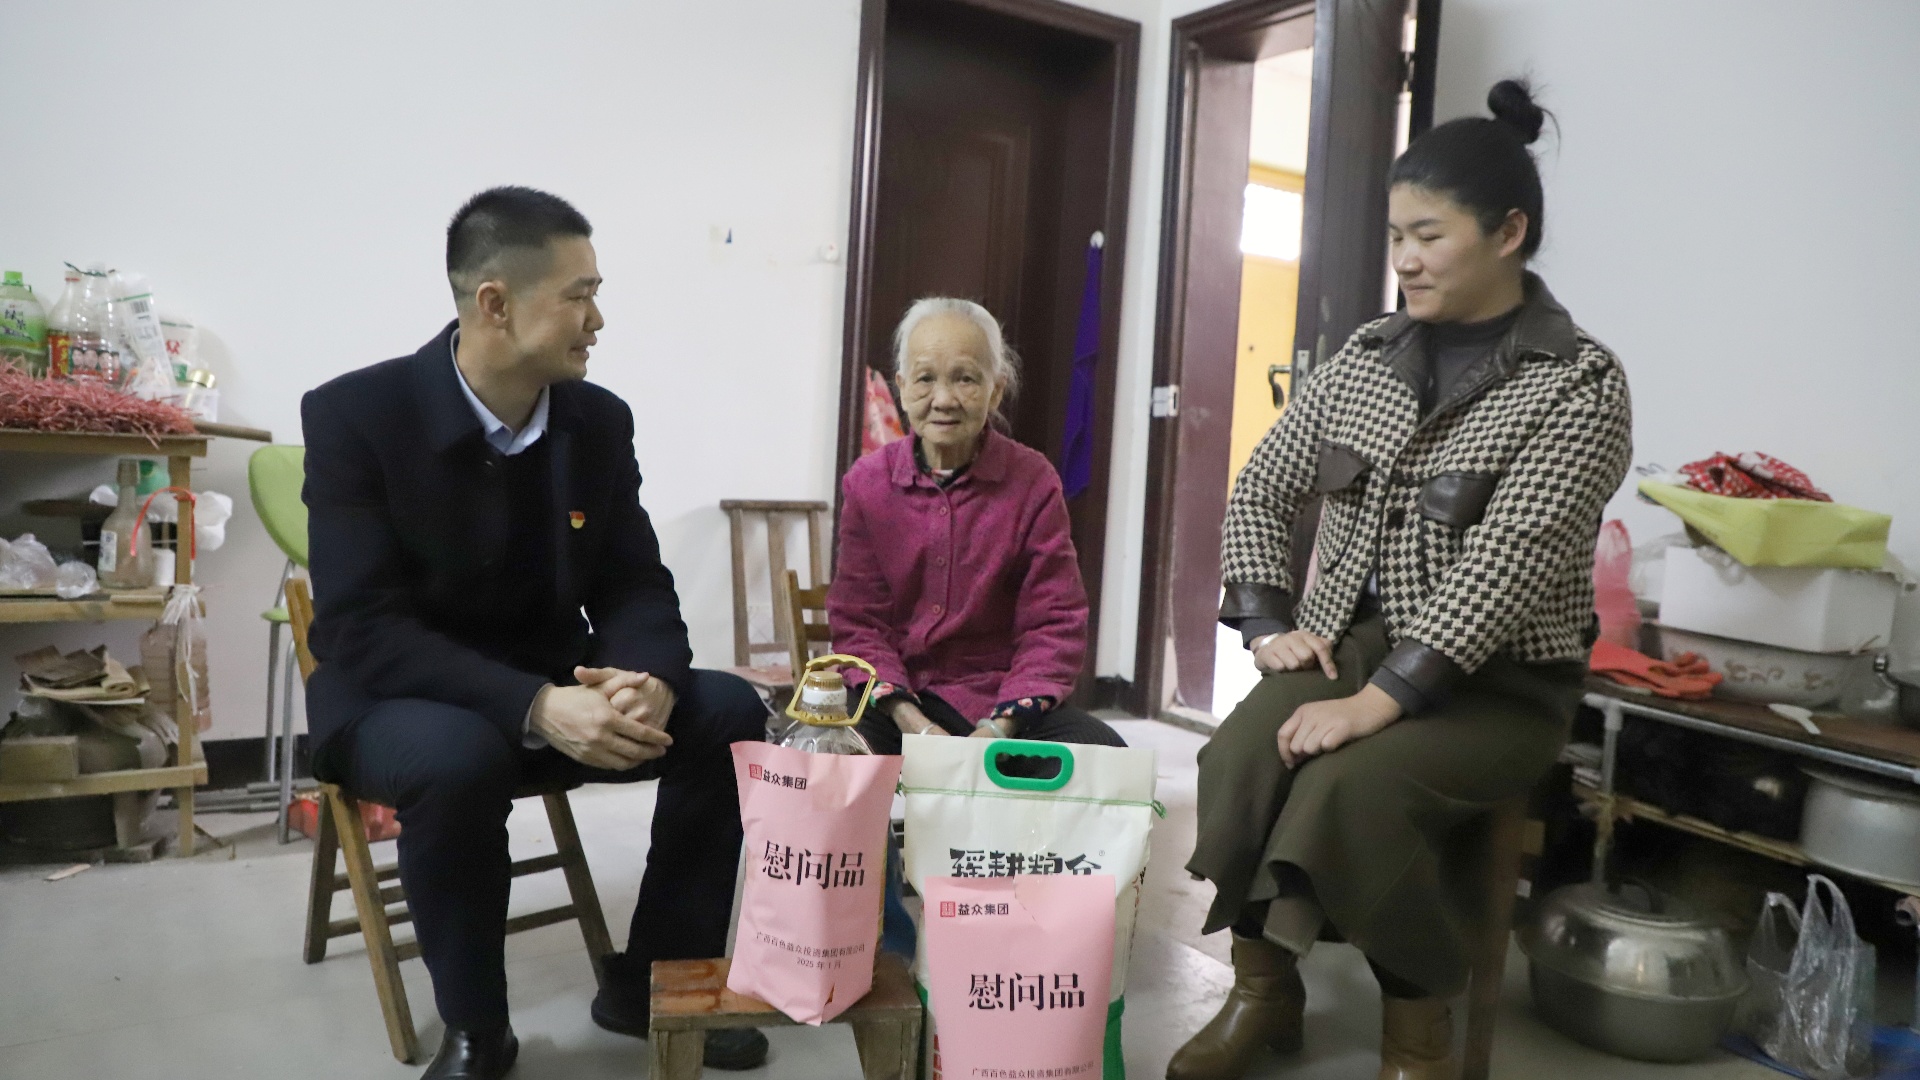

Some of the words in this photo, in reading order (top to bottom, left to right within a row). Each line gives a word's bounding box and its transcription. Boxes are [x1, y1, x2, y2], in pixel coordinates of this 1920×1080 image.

[763, 769, 807, 790] 益众集团
[762, 839, 865, 889] 慰问品
[958, 903, 1009, 916] 益众集团
[968, 973, 1086, 1011] 慰问品
